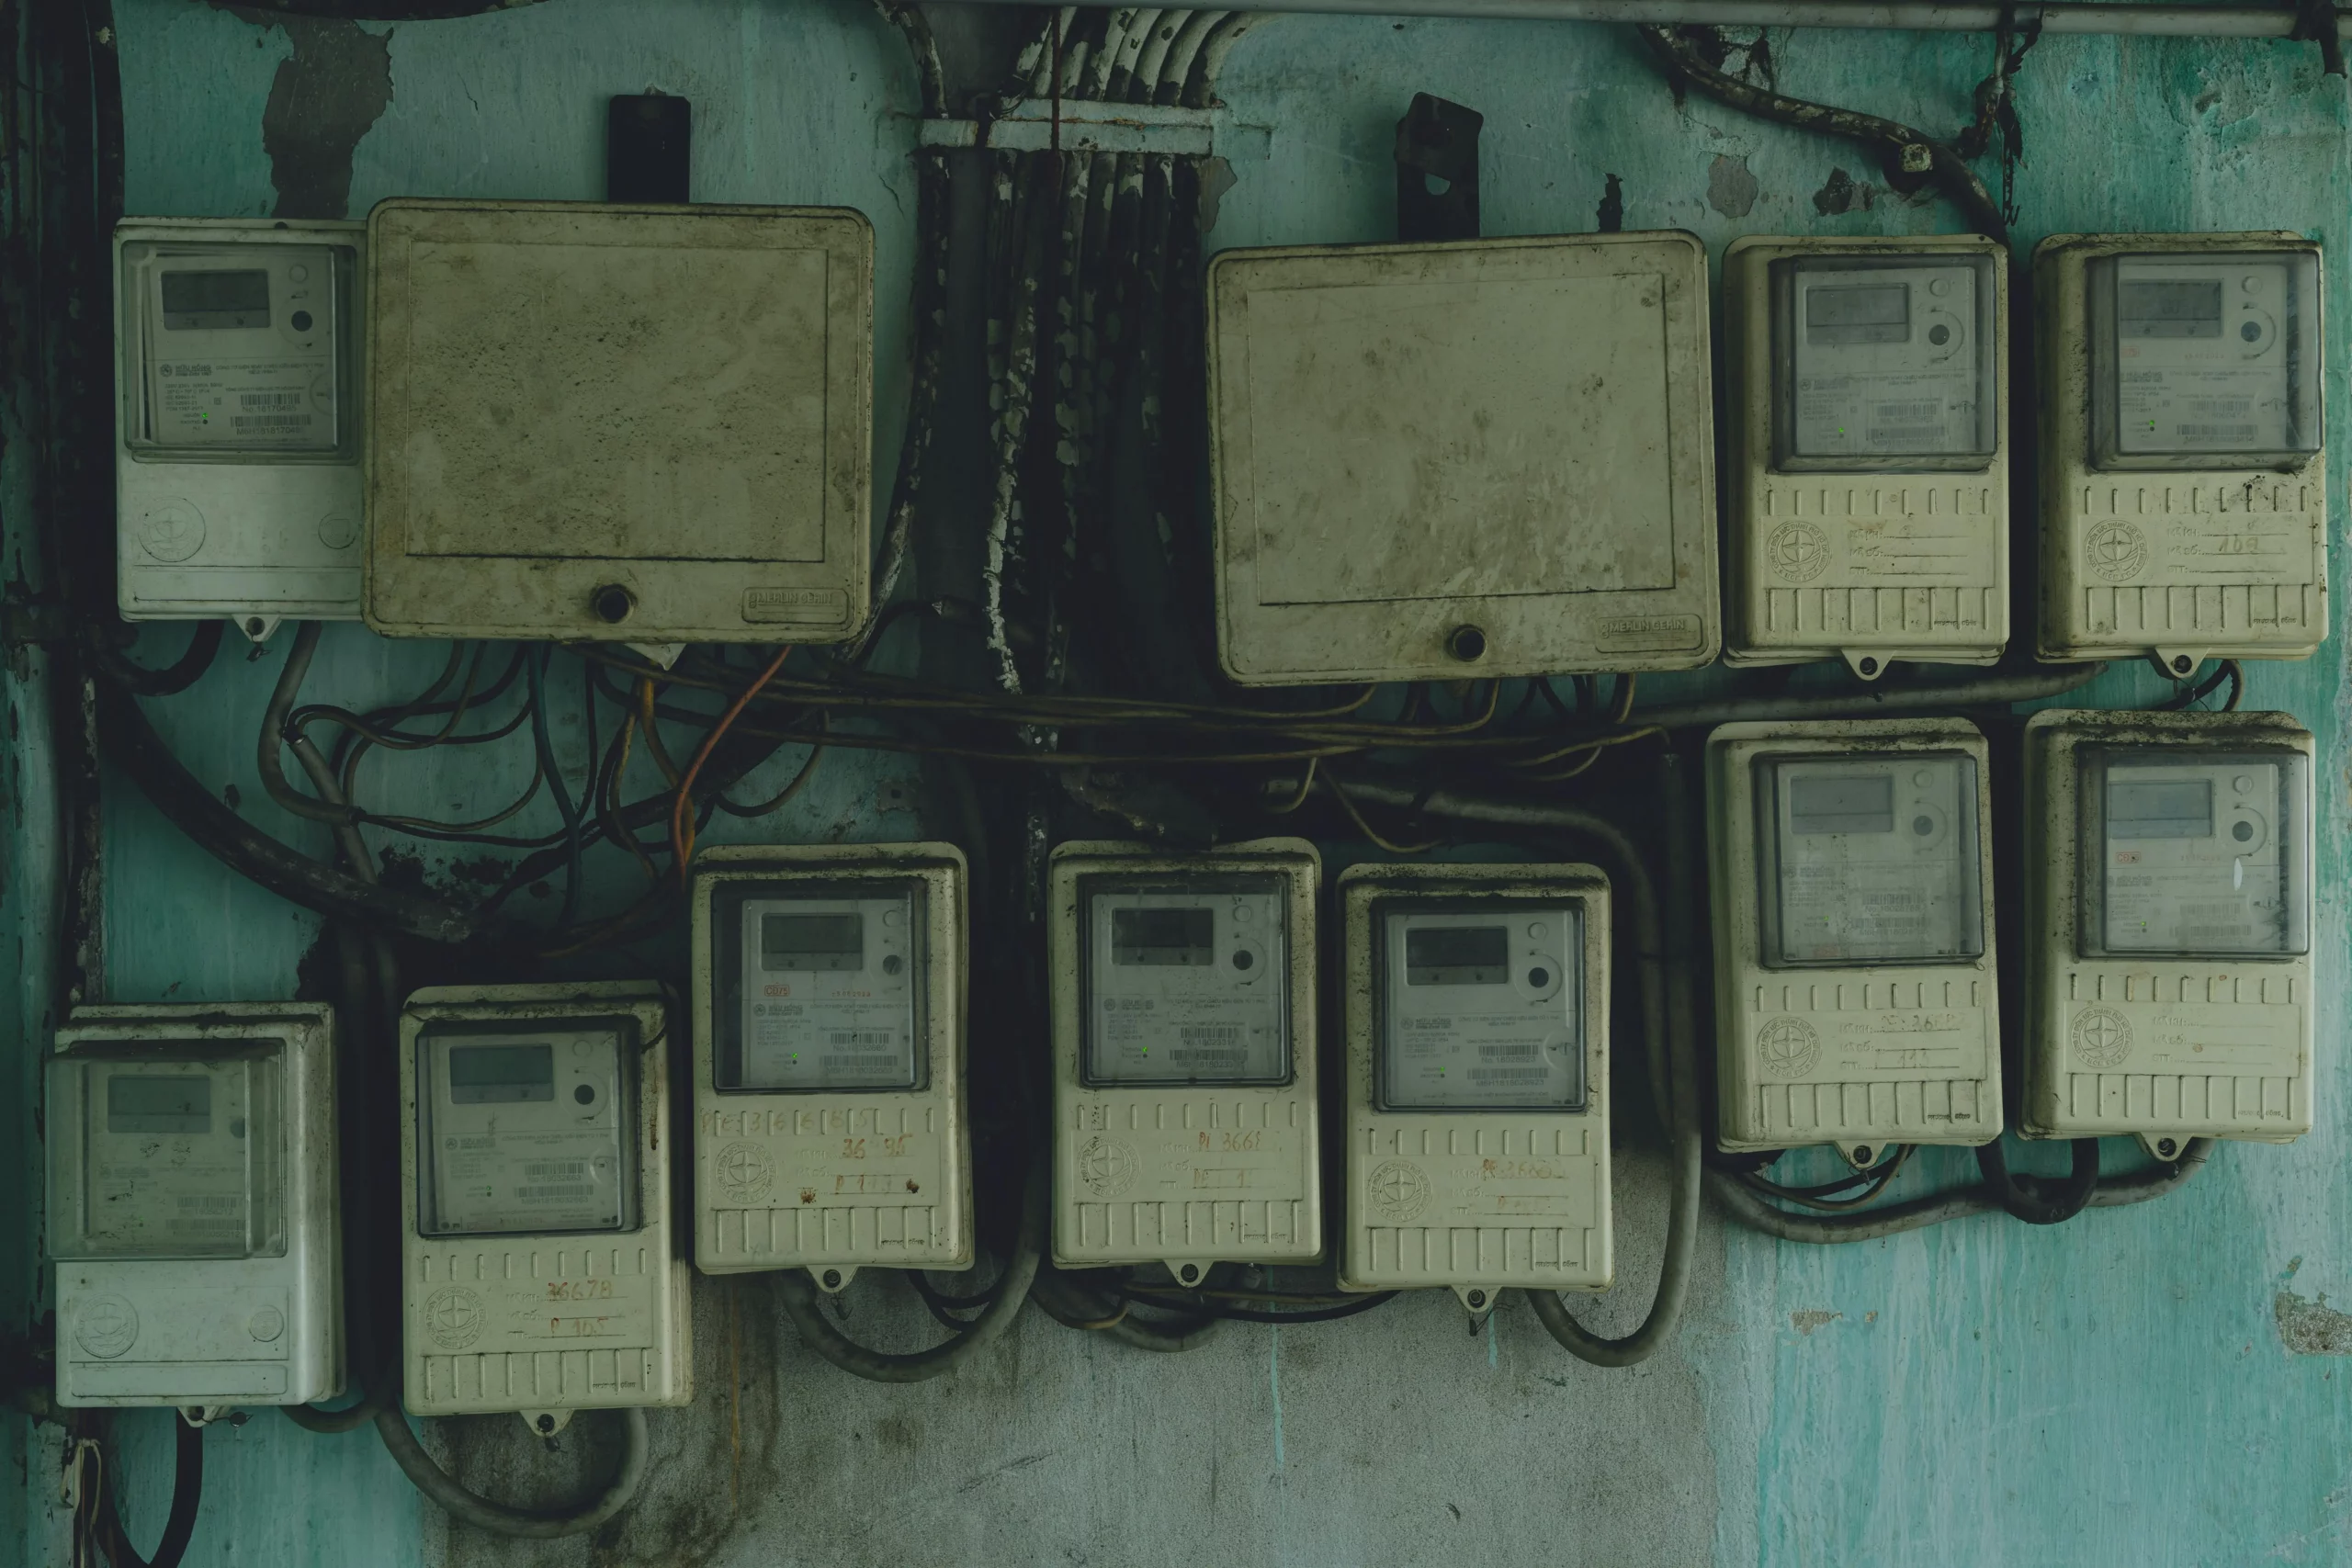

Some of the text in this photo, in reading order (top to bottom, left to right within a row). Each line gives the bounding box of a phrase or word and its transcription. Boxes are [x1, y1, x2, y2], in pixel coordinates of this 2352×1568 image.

[757, 592, 832, 604] MERLIN GERIN
[1610, 619, 1686, 632] MERLIN GERIN
